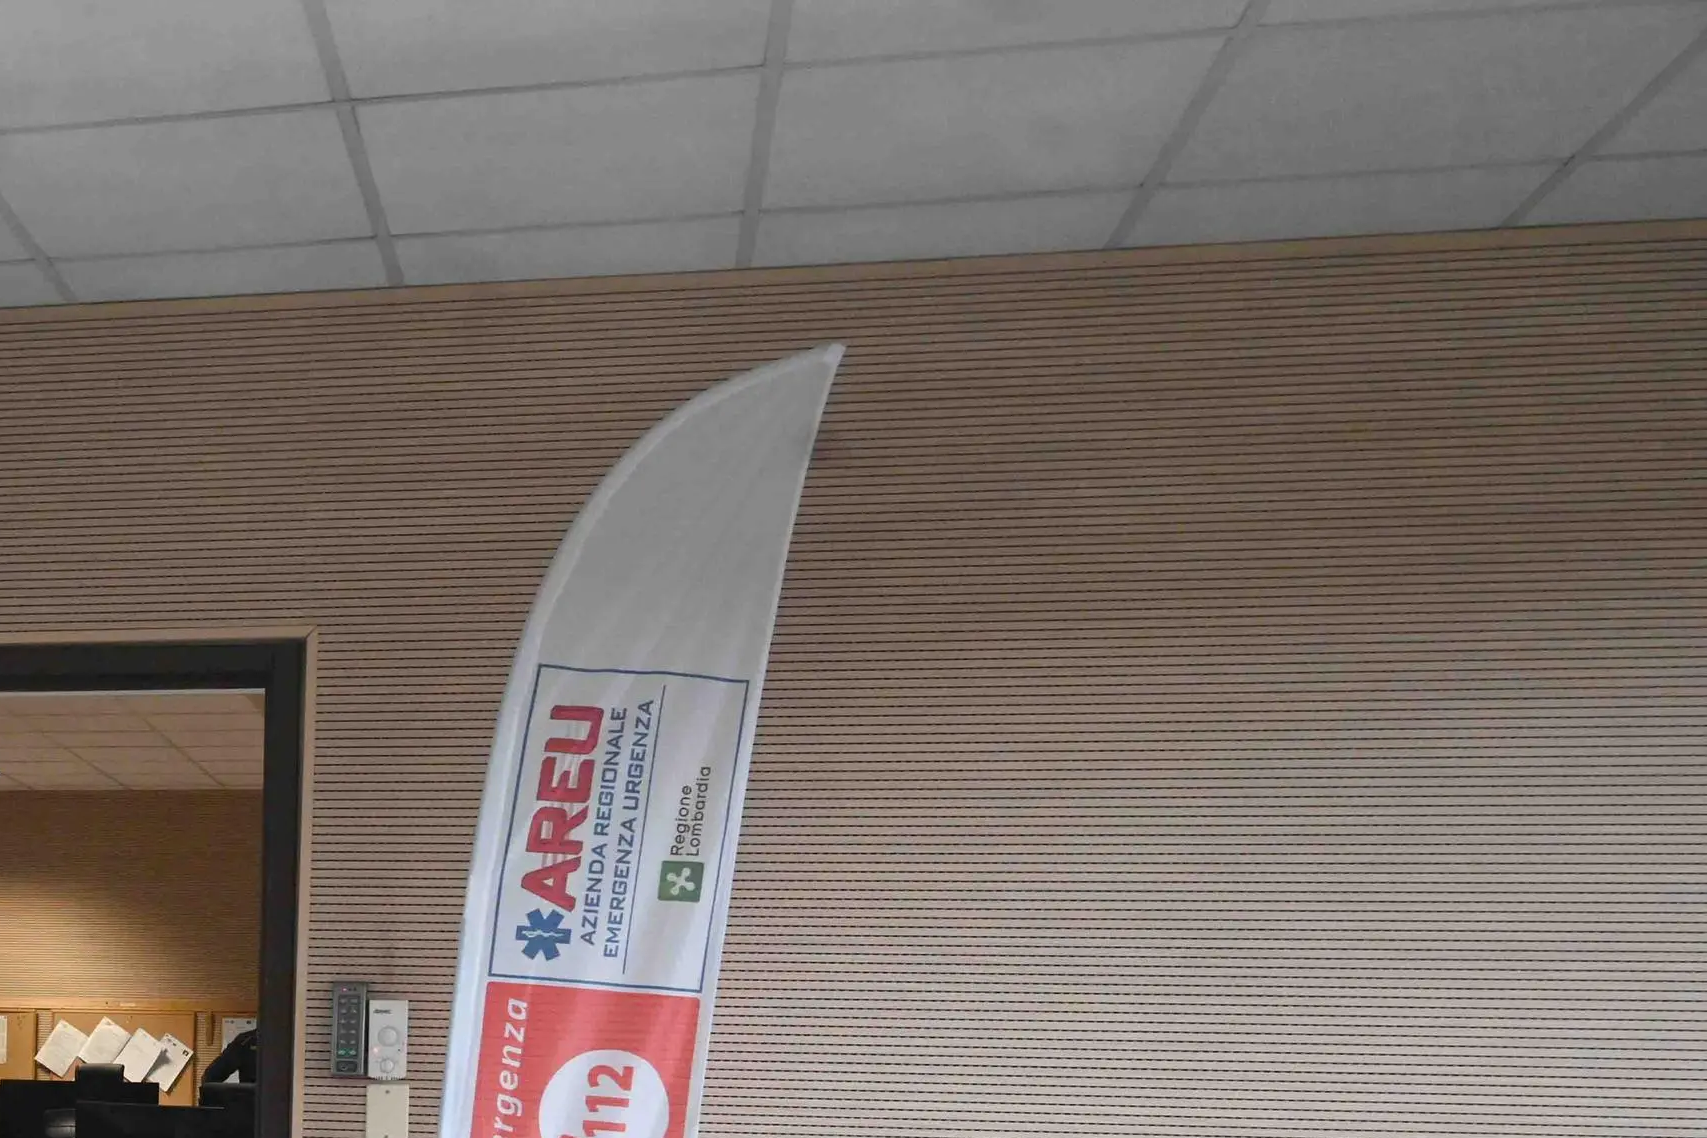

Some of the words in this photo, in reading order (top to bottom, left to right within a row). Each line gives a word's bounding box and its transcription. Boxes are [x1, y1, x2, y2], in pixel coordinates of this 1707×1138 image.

[521, 704, 605, 912] AREU
[580, 843, 607, 946] AZIENDA
[594, 707, 628, 837] REGIONALE
[604, 819, 634, 958] EMERGENZA
[623, 699, 654, 811] URGENZA
[670, 784, 693, 857] Regione
[686, 765, 711, 857] Lombardia
[582, 1063, 635, 1138] 112
